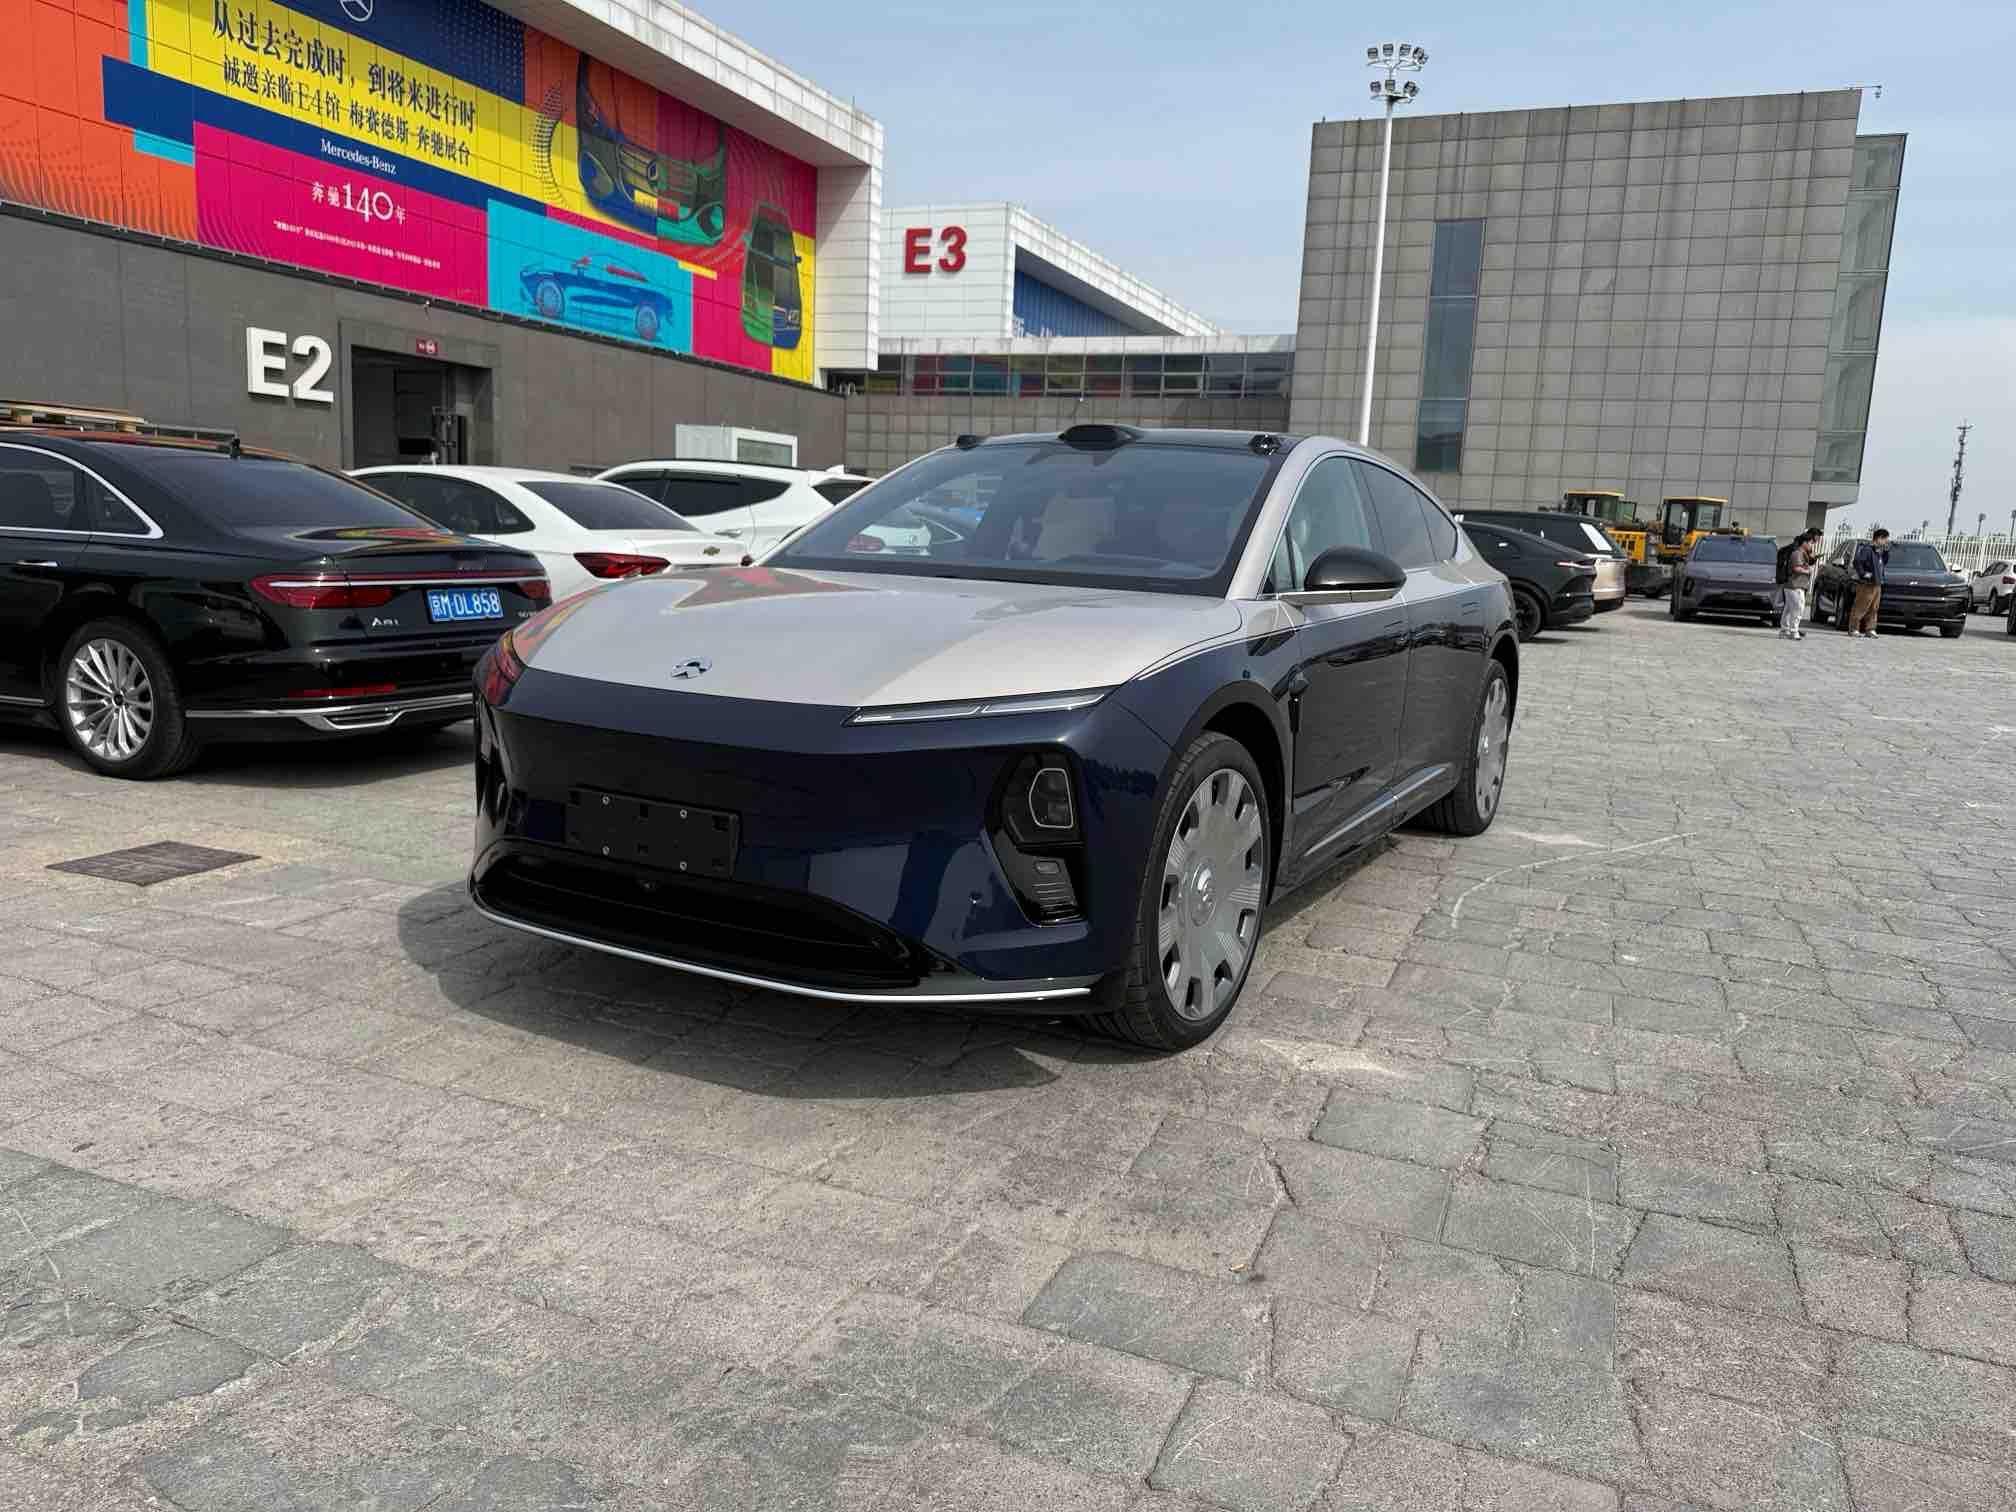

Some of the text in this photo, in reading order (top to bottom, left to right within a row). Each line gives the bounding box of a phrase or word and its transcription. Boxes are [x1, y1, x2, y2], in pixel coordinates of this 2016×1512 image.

[320, 138, 397, 175] Mercedes-Benz
[905, 226, 967, 273] E3
[246, 327, 334, 403] E2
